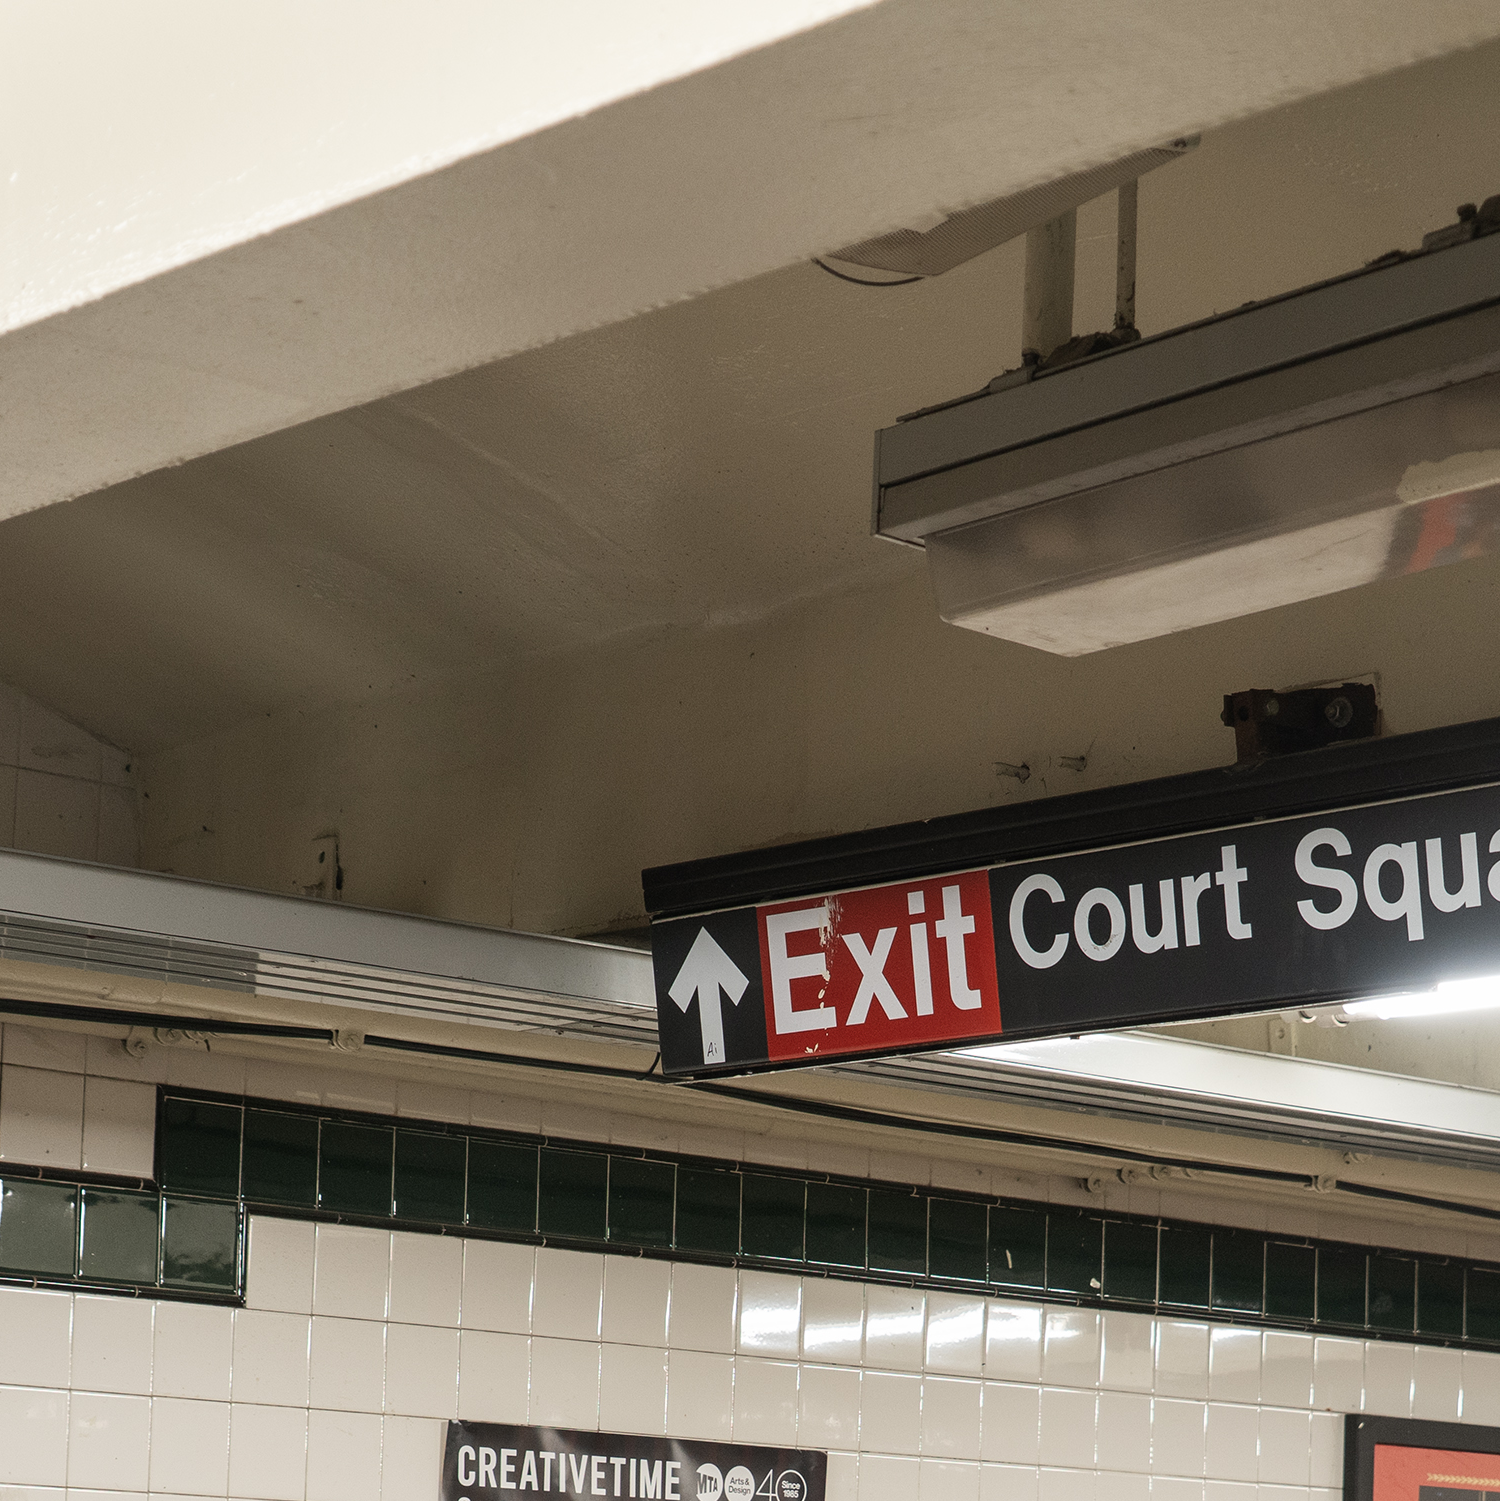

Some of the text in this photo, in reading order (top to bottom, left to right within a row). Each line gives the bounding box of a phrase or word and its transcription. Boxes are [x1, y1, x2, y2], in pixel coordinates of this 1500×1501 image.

[765, 884, 981, 1033] Exit
[1009, 844, 1251, 969] Court
[457, 1445, 681, 1500] CREATIVETIME
[698, 1472, 718, 1494] MTA
[730, 1477, 744, 1485] Arts
[782, 1481, 800, 1489] Since
[729, 1486, 751, 1495] Design
[783, 1490, 799, 1498] 1985
